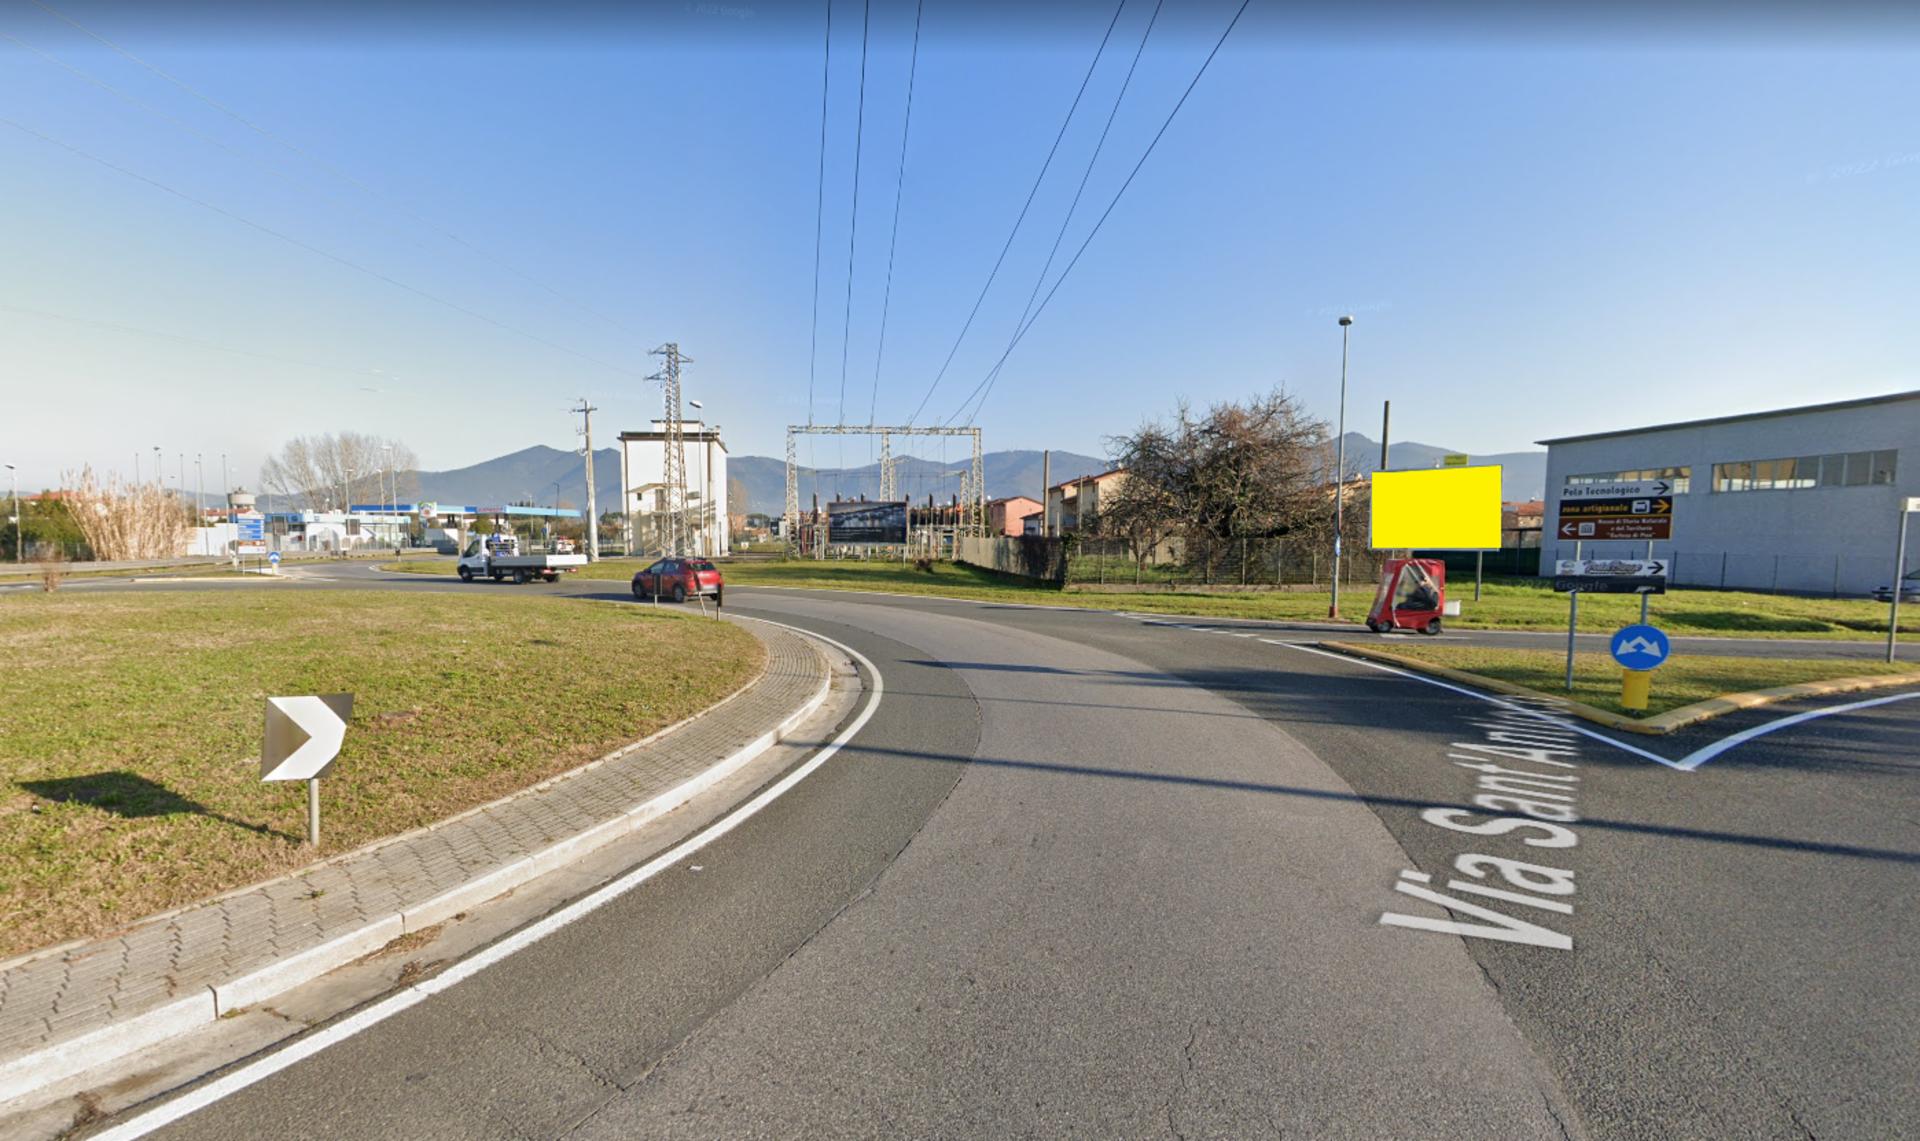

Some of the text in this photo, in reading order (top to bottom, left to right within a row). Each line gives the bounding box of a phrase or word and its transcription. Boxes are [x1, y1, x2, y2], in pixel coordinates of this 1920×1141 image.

[1563, 486, 1641, 497] Polo Tecnologico
[1583, 503, 1629, 513] artigianale
